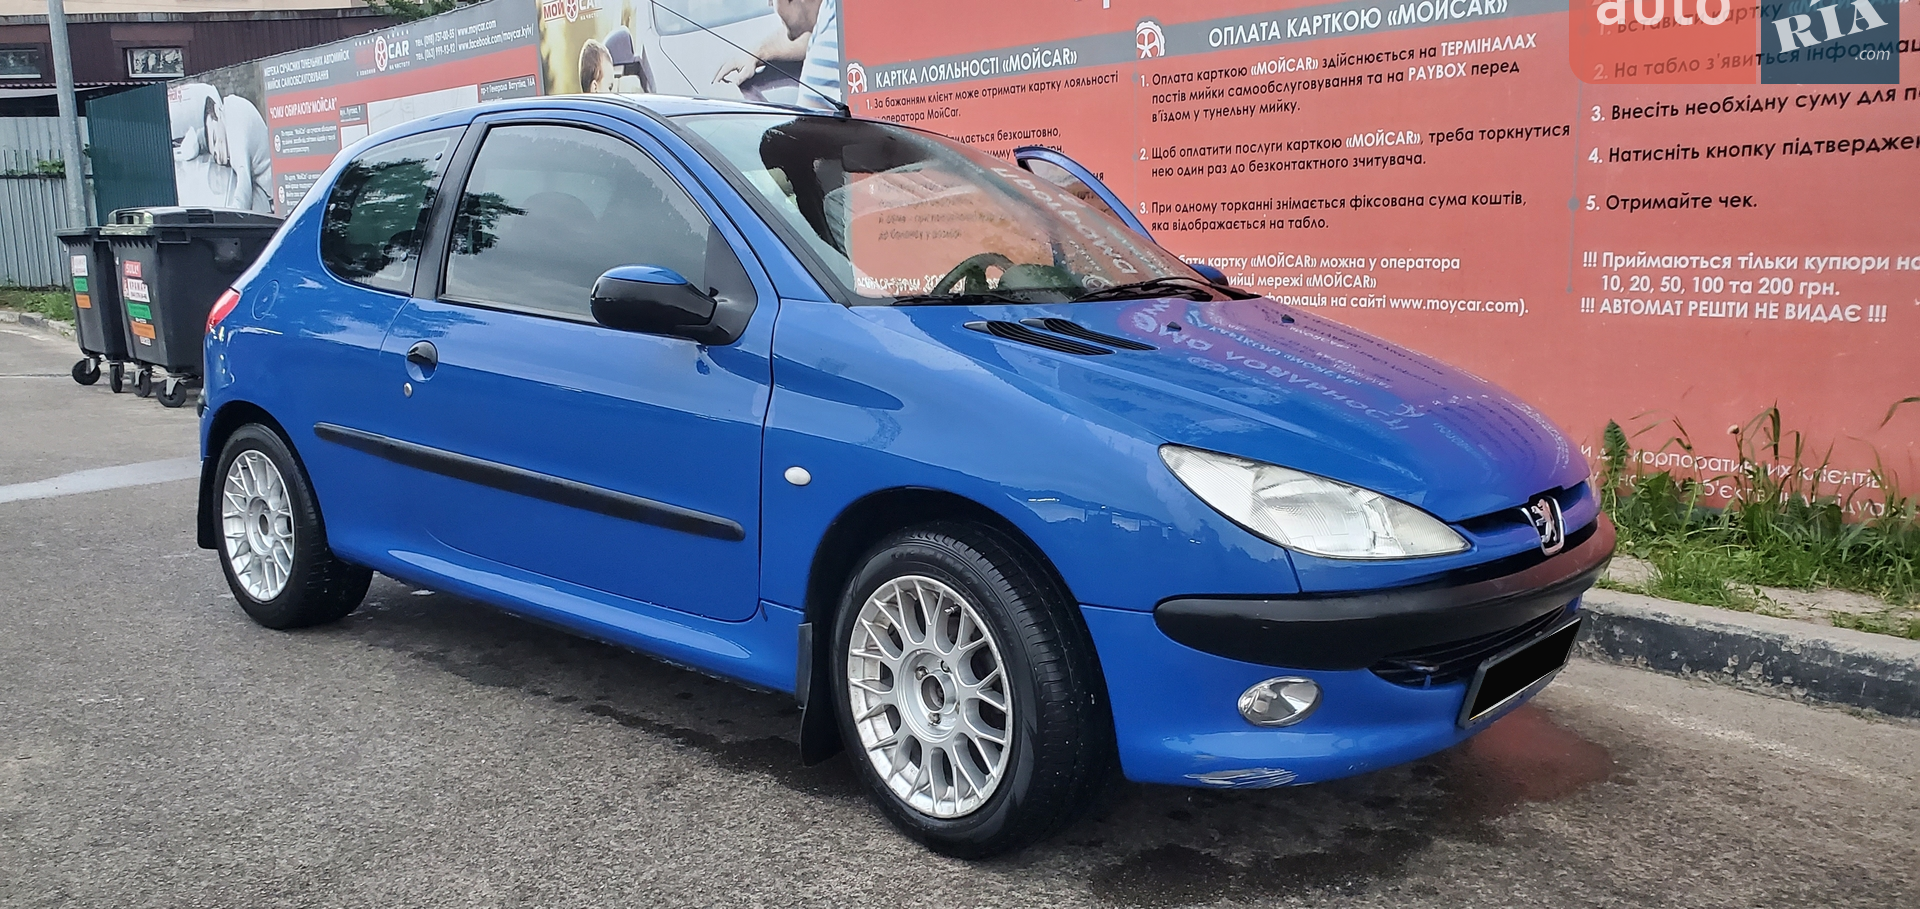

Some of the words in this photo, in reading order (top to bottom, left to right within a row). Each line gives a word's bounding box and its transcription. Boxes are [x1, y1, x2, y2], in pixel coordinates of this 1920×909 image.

[1208, 20, 1281, 48] ОПЛАТА
[1287, 10, 1382, 39] КАРТКОЮ
[388, 40, 410, 59] CAR
[1140, 75, 1150, 88] 1.
[1152, 73, 1193, 86] Оплата
[1197, 67, 1248, 83] карткою
[1322, 48, 1415, 68] здійснюється
[1419, 46, 1437, 59] на
[1441, 33, 1537, 57] ТЕРМІНАЛАХ
[875, 67, 918, 89] КАРТКА
[920, 57, 999, 83] ЛОЯЛЬНОСТІ
[1615, 62, 1638, 78] На
[1644, 57, 1700, 76] табло
[874, 98, 884, 109] За
[885, 94, 927, 107] бажанням
[928, 90, 953, 104] клієнт
[955, 89, 980, 100] може
[982, 83, 1026, 100] отримати
[1028, 78, 1061, 94] картку
[1063, 71, 1119, 88] лояльності
[1152, 90, 1186, 104] постів
[1189, 86, 1224, 101] мийки
[1228, 75, 1363, 98] самообслуговування
[1367, 72, 1383, 85] та
[1387, 70, 1404, 83] на
[1408, 62, 1467, 82] PAYBOX
[1471, 61, 1520, 77] перед
[1193, 109, 1200, 121] у
[1203, 104, 1256, 120] тунельну
[1259, 100, 1301, 115] мийку.
[1591, 106, 1605, 122] 3.
[1611, 101, 1679, 120] Внесіть
[1685, 95, 1789, 116] необхідну
[1796, 92, 1851, 111] суму
[1857, 89, 1896, 105] для
[1905, 87, 1920, 101] п
[949, 134, 995, 144] идається
[997, 127, 1061, 141] безкоштовно,
[1140, 148, 1149, 161] 2.
[1151, 146, 1177, 160] Щоб
[1179, 144, 1232, 158] оплатити
[1235, 141, 1283, 157] послуги
[1286, 137, 1342, 153] карткою
[1428, 127, 1474, 146] треба
[1479, 124, 1571, 141] торкнутися
[1588, 147, 1603, 164] 4.
[1609, 144, 1700, 163] Натисніть
[1706, 143, 1776, 160] кнопку
[1151, 166, 1174, 178] нею
[1177, 165, 1204, 178] один
[1207, 164, 1227, 178] раз
[1230, 162, 1246, 175] до
[1249, 157, 1349, 173] безконтактного
[1352, 153, 1427, 170] зчитувача.
[1140, 202, 1149, 215] 3.
[1151, 201, 1172, 216] При
[1175, 202, 1217, 215] одному
[1220, 197, 1273, 215] торканні
[1276, 197, 1346, 211] знімається
[1349, 194, 1424, 211] фіксована
[1428, 194, 1467, 209] сума
[1471, 190, 1527, 207] коштів,
[1586, 195, 1600, 211] 5.
[1606, 192, 1713, 213] Отримайте
[1719, 195, 1758, 208] чек.
[1151, 221, 1169, 232] яка
[1172, 218, 1266, 233] відображається
[1269, 218, 1284, 229] на
[1287, 216, 1329, 230] табло.
[1207, 256, 1248, 270] картку
[1320, 257, 1365, 269] можна
[1369, 258, 1377, 271] у
[1380, 257, 1461, 272] оператора
[1602, 251, 1732, 271] Приймаються
[1737, 252, 1799, 270] тільки
[1804, 256, 1890, 274] купюри
[1257, 275, 1303, 289] мережі
[1601, 275, 1624, 293] 10,
[1629, 275, 1654, 294] 20,
[1660, 276, 1685, 294] 50,
[1693, 276, 1724, 294] 100
[1729, 280, 1752, 294] та
[1758, 277, 1794, 295] 200
[1799, 282, 1840, 299] грн.
[1331, 296, 1347, 307] на
[1350, 294, 1386, 308] сайті
[1389, 297, 1529, 317] www.moycar.com).
[1599, 298, 1683, 316] АВТОМАТ
[1688, 301, 1748, 318] РЕШТИ
[1755, 302, 1779, 319] НЕ
[1785, 303, 1862, 323] ВИДАЄ
